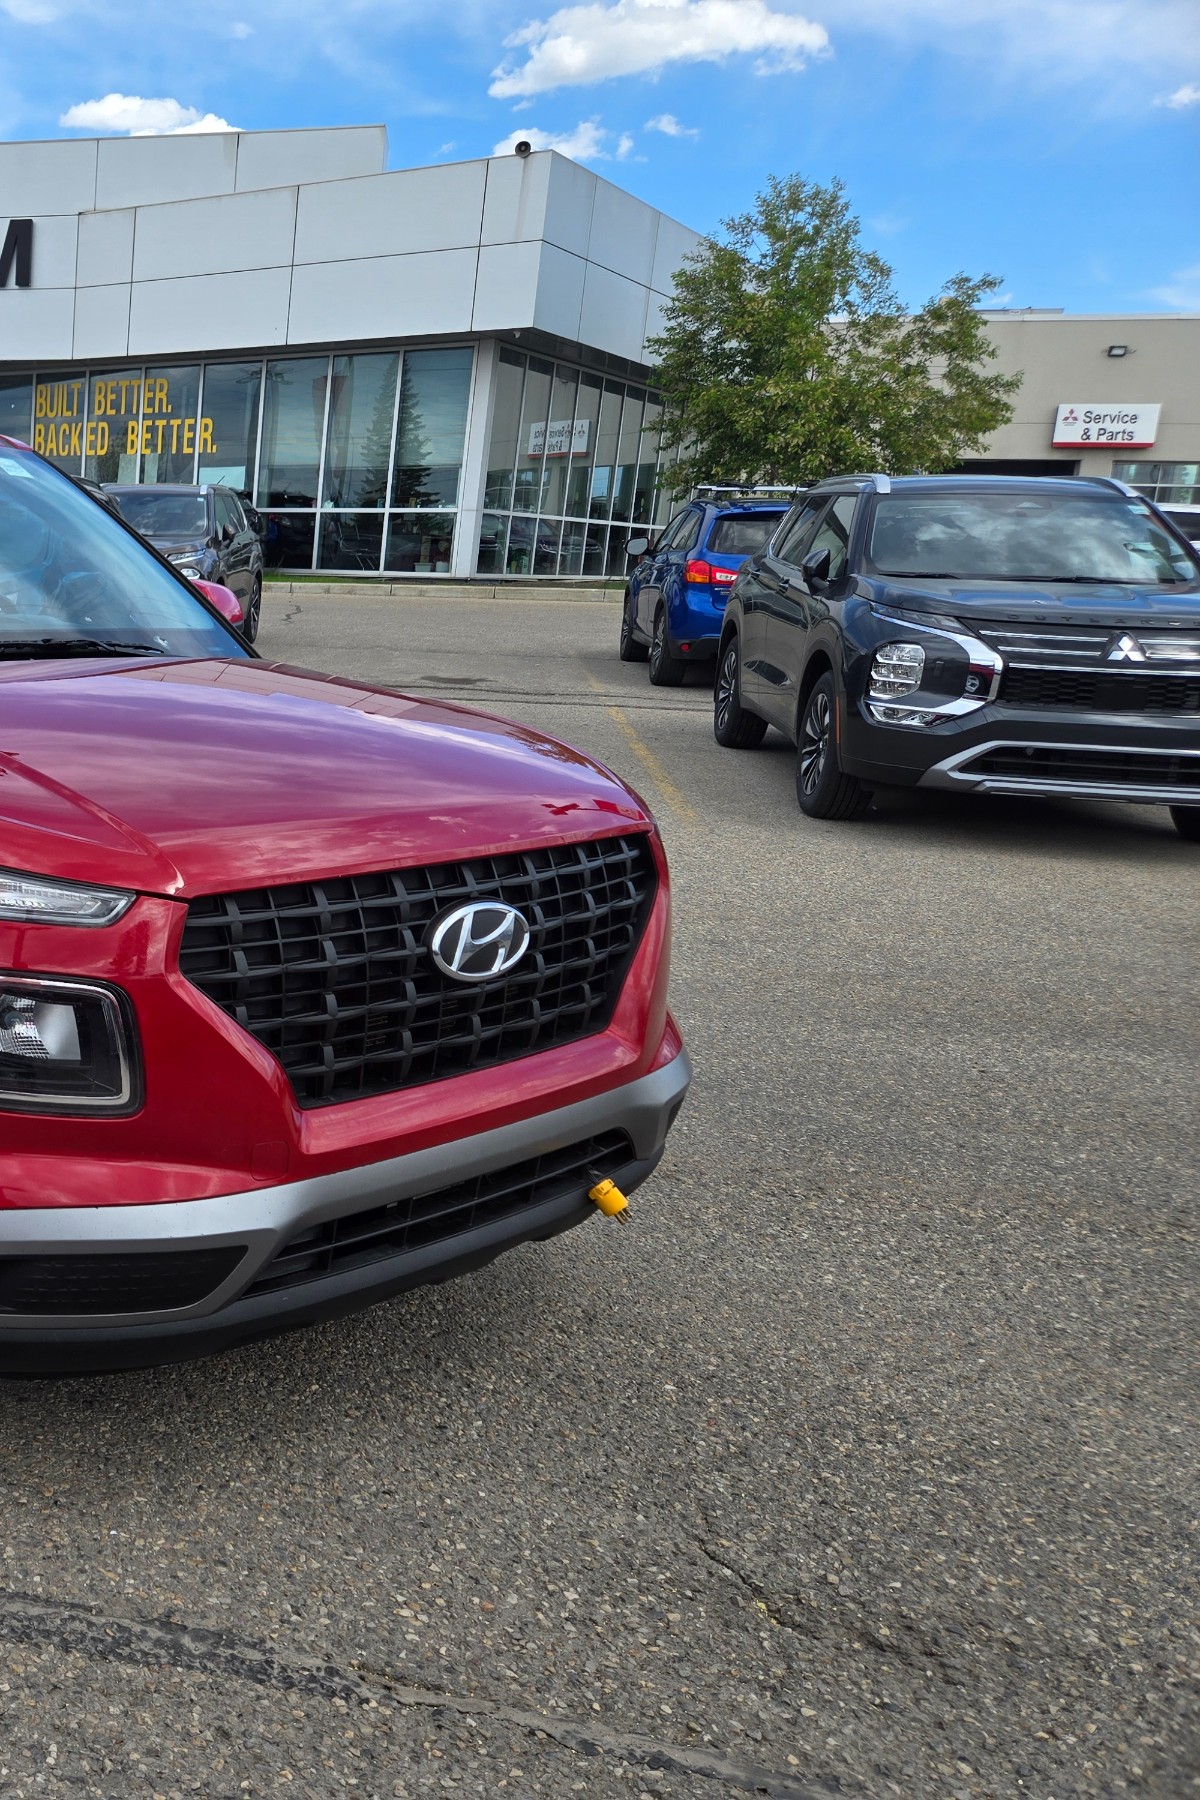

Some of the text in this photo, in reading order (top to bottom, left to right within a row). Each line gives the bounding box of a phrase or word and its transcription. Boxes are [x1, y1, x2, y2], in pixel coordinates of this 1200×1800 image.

[35, 378, 172, 418] BUILT BETTER.
[1082, 410, 1138, 424] Service
[34, 417, 217, 457] BACKED BETTER.
[1080, 427, 1134, 441] & Parts
